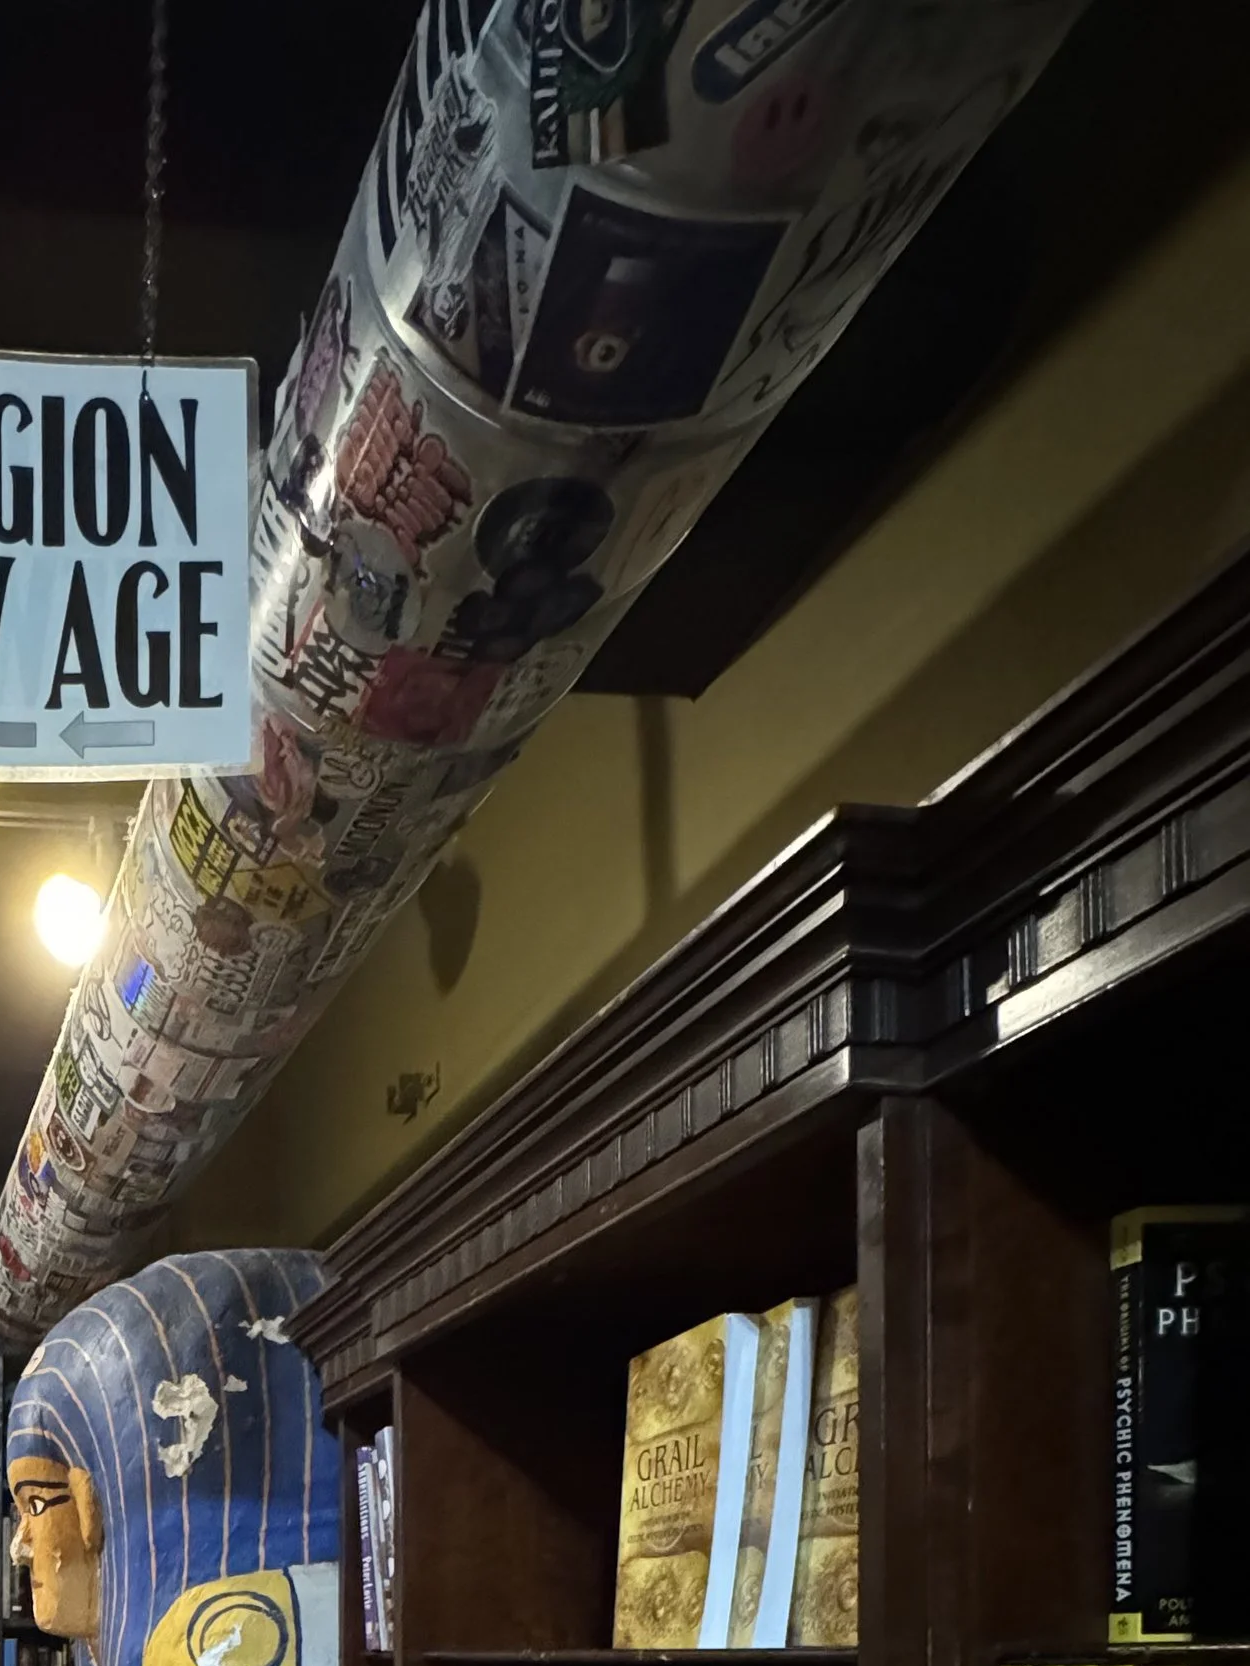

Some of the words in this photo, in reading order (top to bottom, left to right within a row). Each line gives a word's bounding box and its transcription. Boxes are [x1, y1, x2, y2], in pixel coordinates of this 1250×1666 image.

[45, 560, 223, 709] AGE
[1116, 1377, 1132, 1464] PSYCHIC
[629, 1469, 711, 1512] ALCHEMY
[637, 1434, 707, 1482] GRAIL
[361, 1555, 372, 1581] Peter
[1115, 1470, 1133, 1602] PHENOMENA
